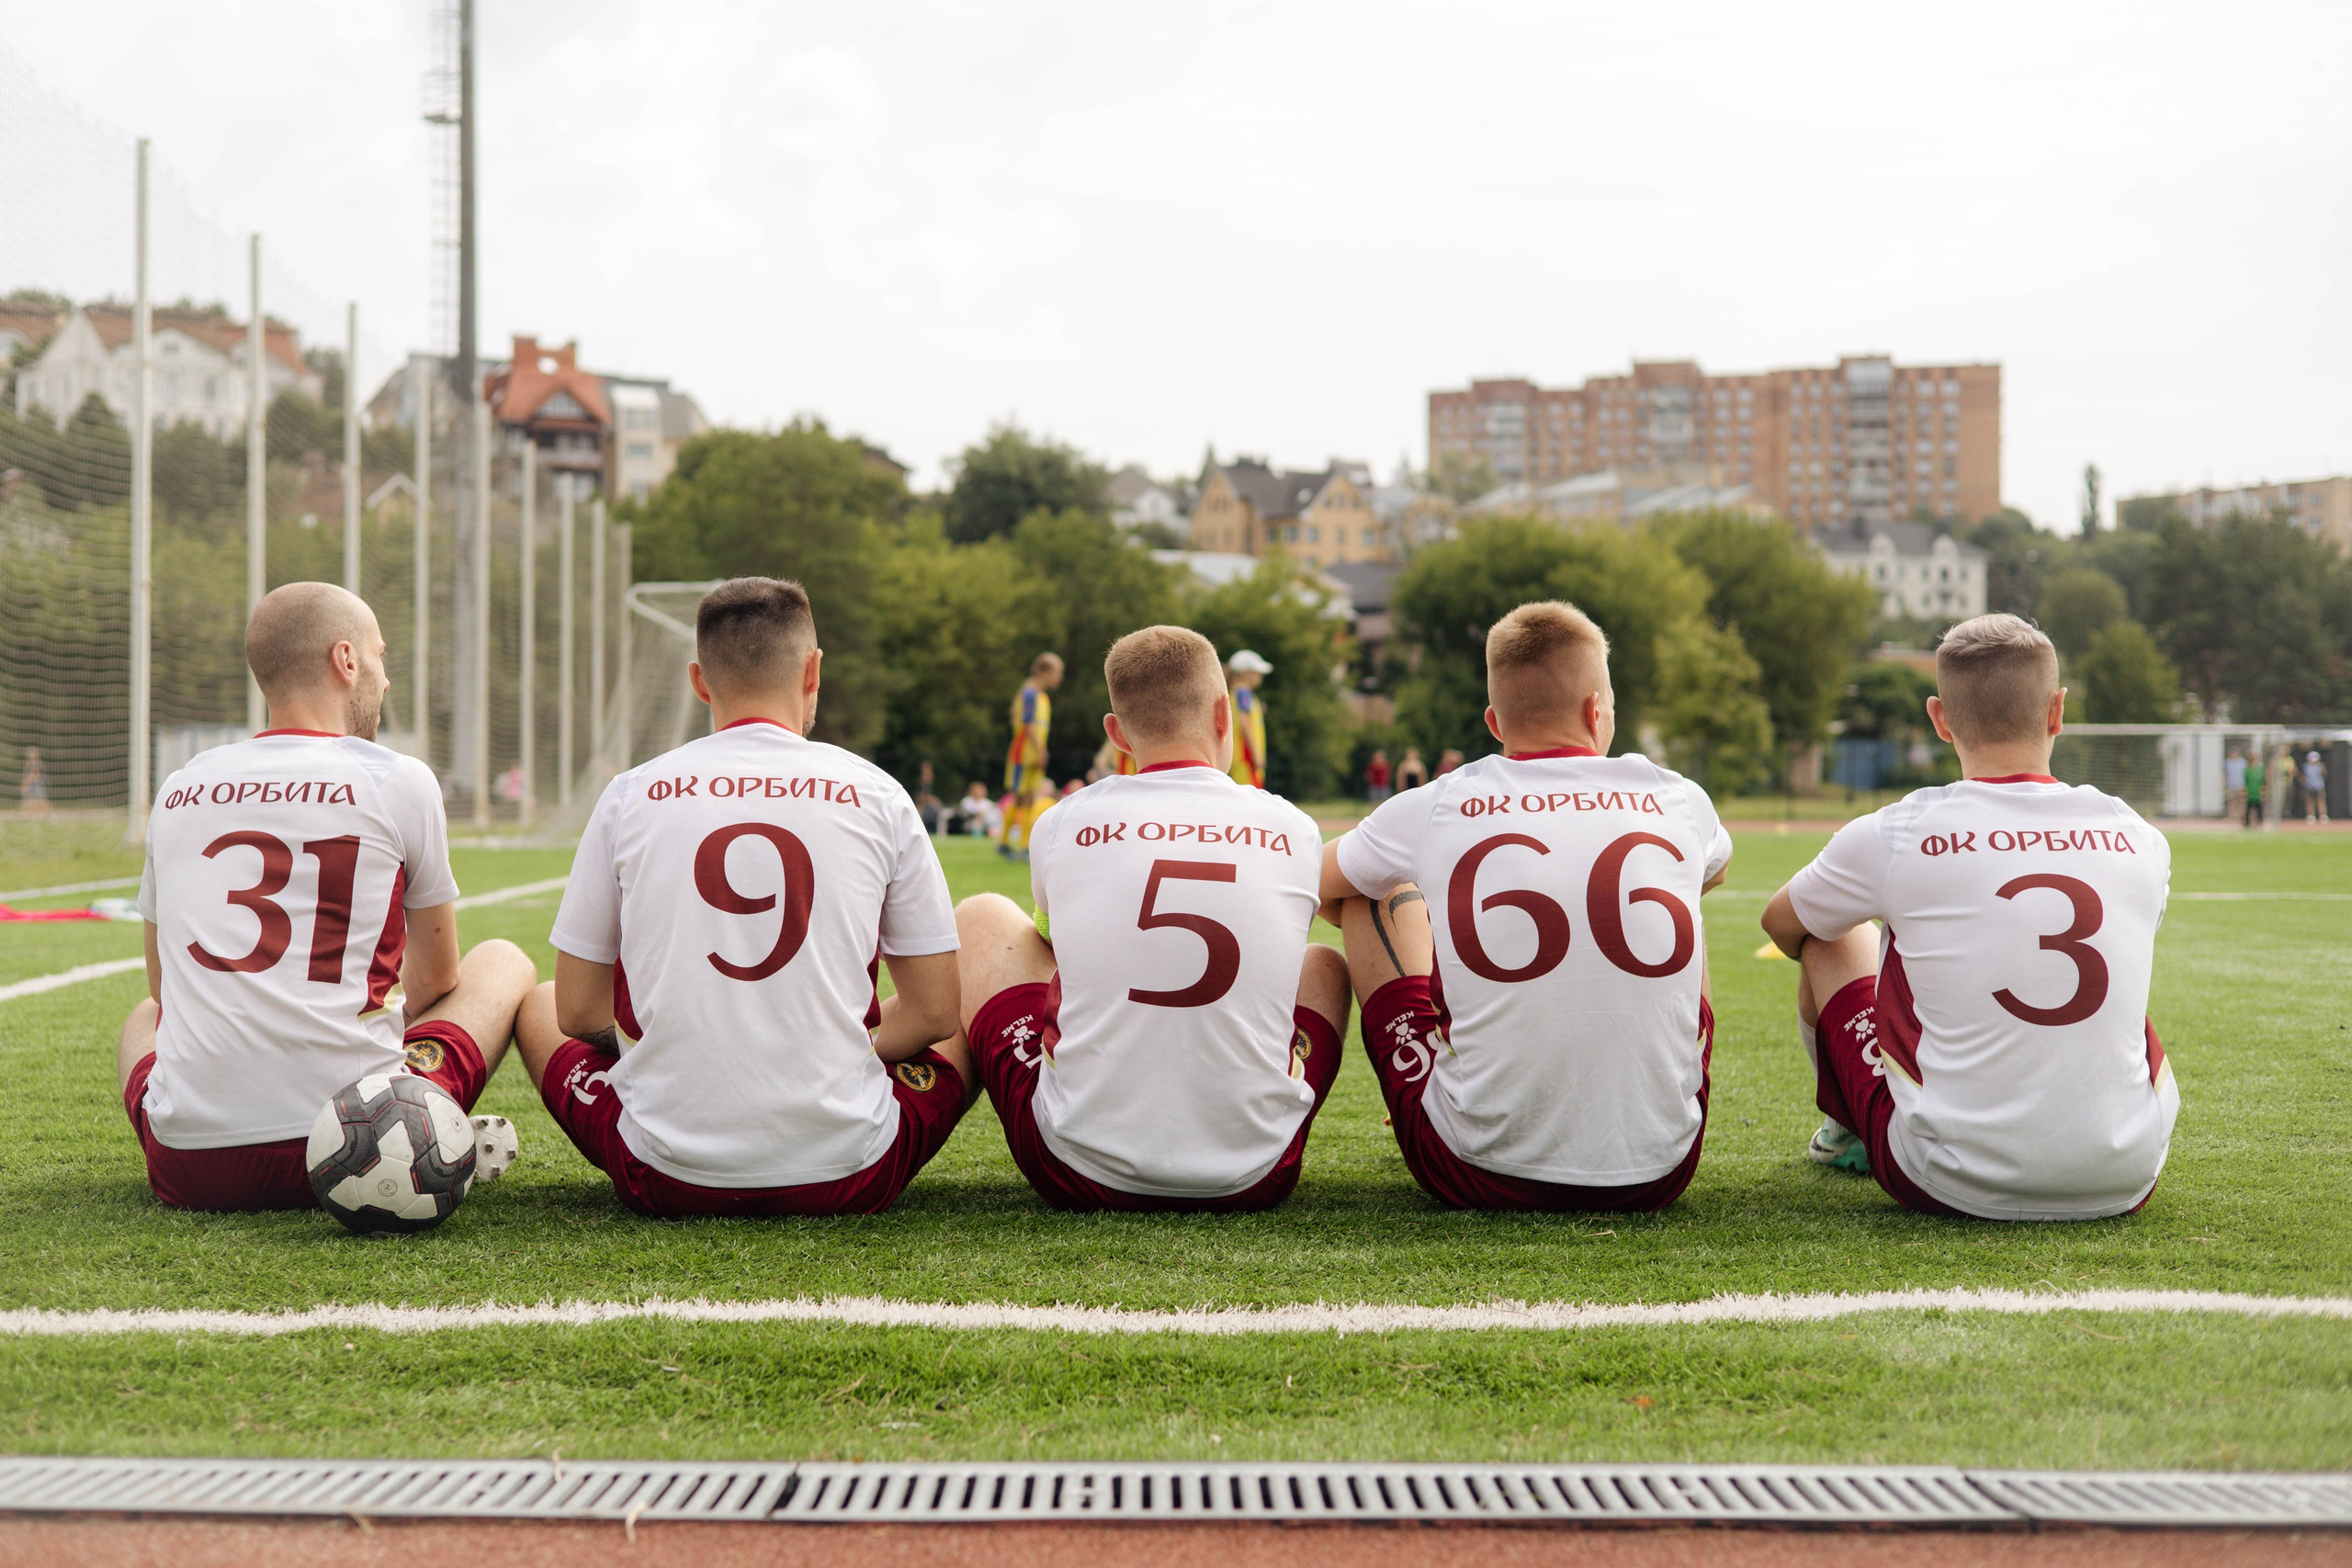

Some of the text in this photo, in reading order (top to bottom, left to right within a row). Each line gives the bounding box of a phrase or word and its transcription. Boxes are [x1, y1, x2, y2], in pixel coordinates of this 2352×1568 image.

[164, 782, 356, 809] ФК ОРБИТА
[647, 775, 861, 808] ФК ОРБИТА
[1460, 791, 1664, 818] ФК ОРБИТА
[1075, 821, 1293, 857] ФК ОРБИТА
[1921, 829, 2137, 857] ФК ОРБИТА
[187, 829, 361, 984] 31
[693, 821, 815, 982] 9
[1447, 830, 1696, 983] 66
[1127, 859, 1241, 1009] 5
[1991, 873, 2109, 1027] 3
[1001, 1014, 1035, 1038] KELME
[1385, 1010, 1415, 1033] KELME
[1843, 1006, 1875, 1032] KELME
[562, 1058, 588, 1089] KELME
